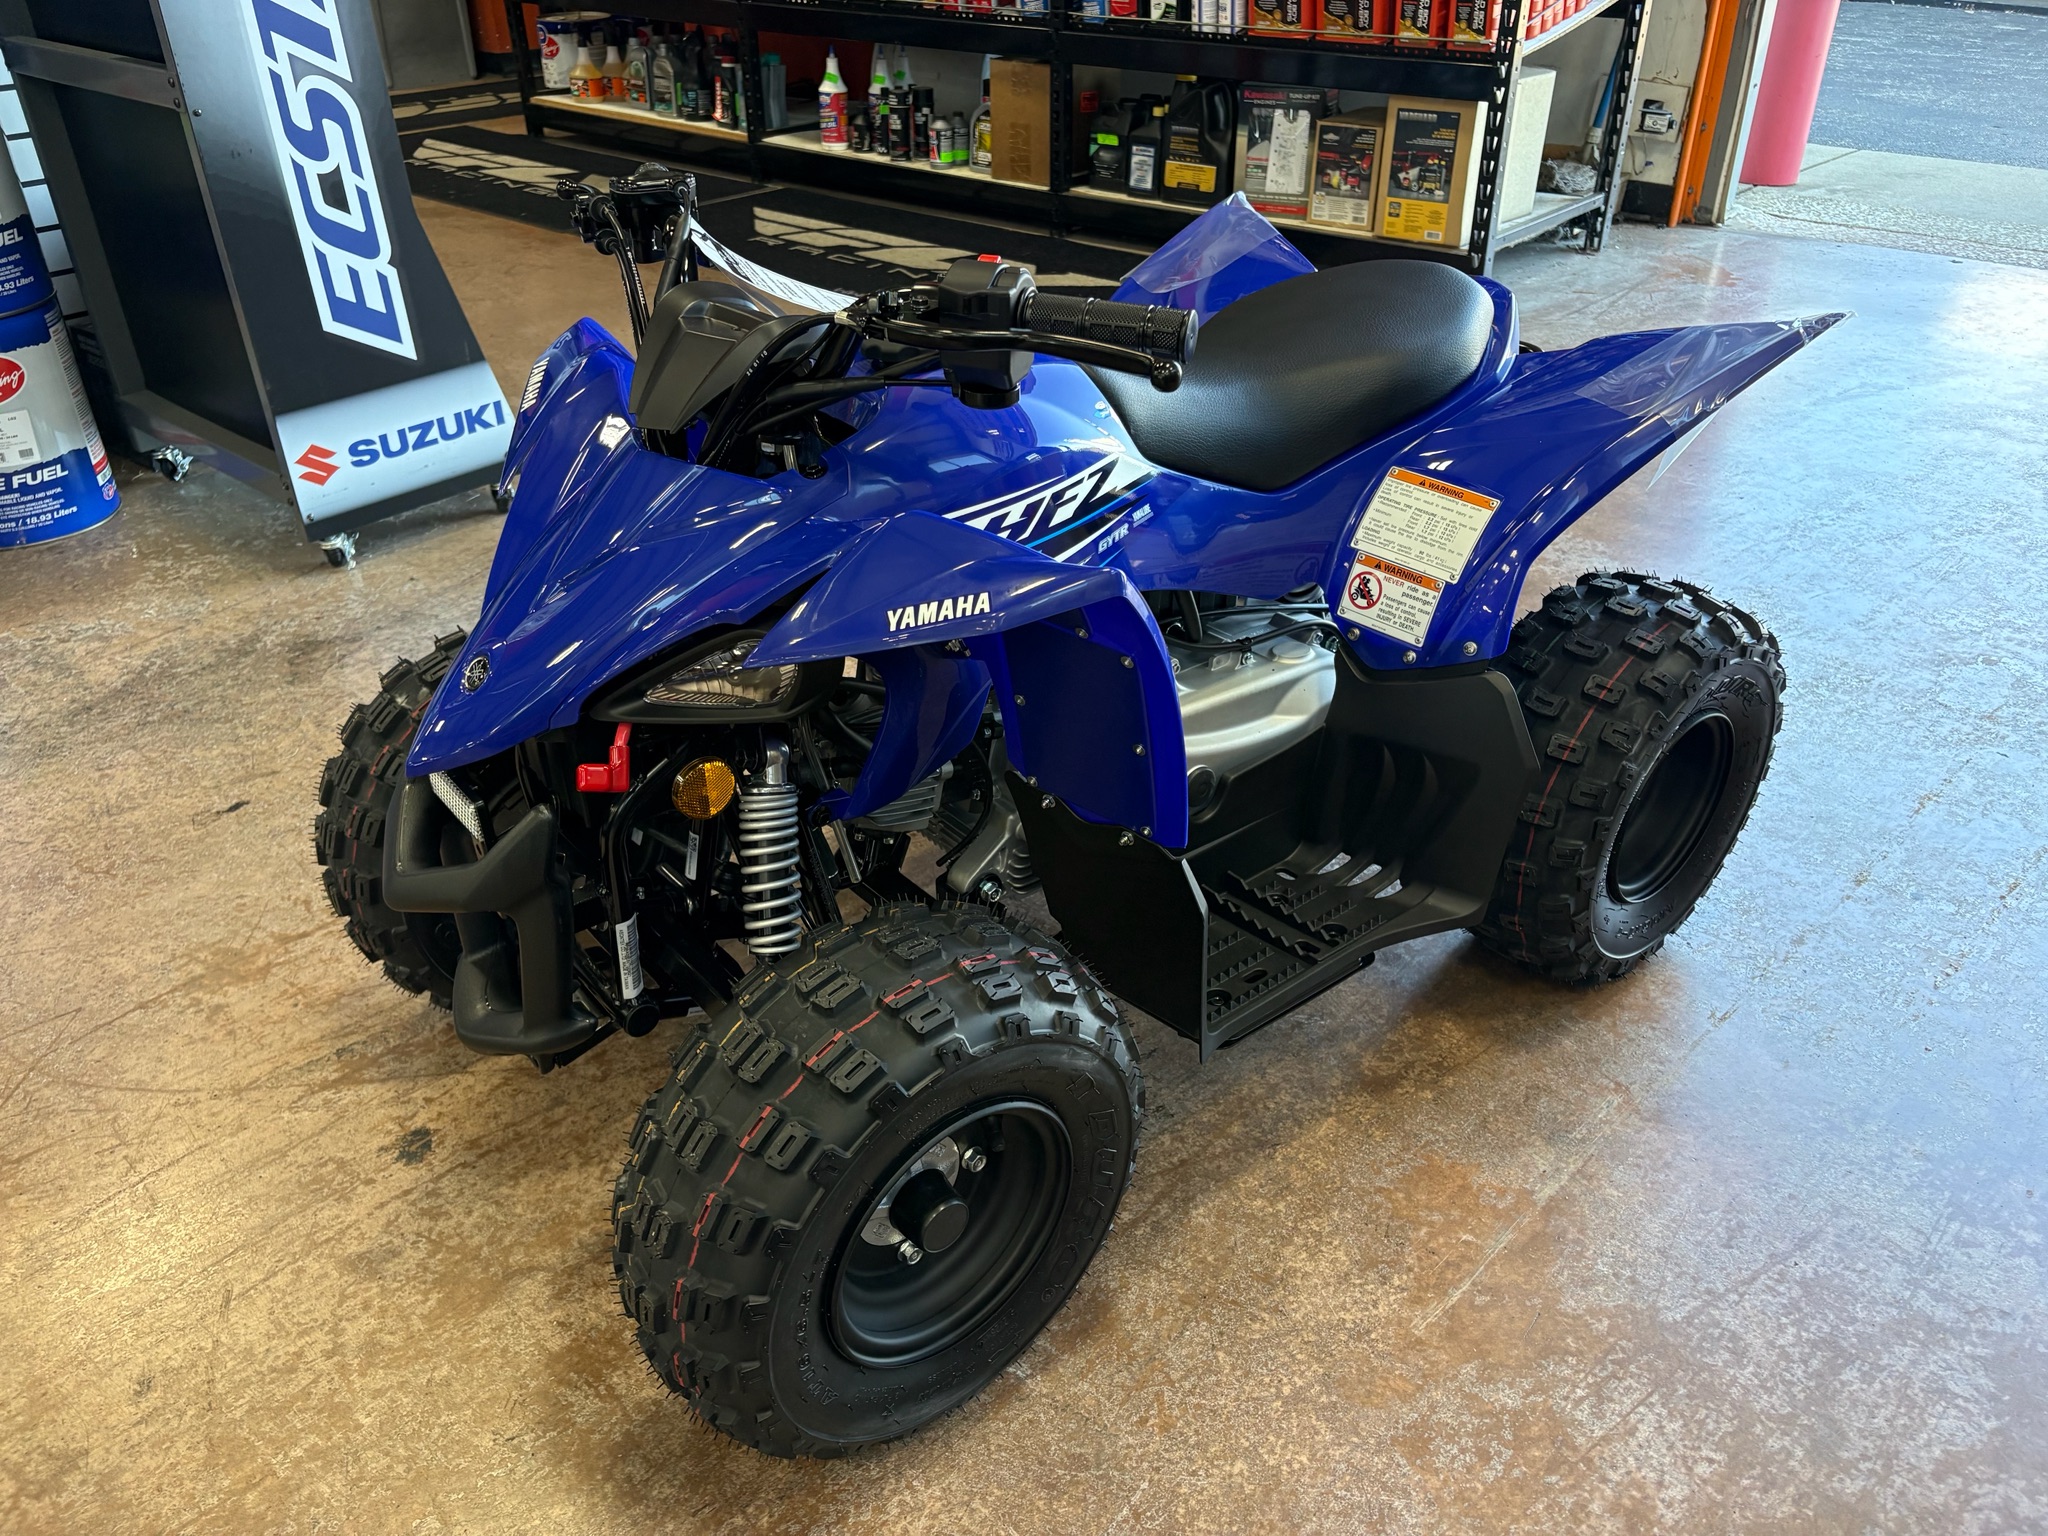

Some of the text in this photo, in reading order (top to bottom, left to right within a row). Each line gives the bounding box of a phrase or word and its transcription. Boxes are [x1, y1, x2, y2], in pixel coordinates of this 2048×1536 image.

[250, 0, 410, 354] ECST
[0, 228, 23, 247] EL
[747, 235, 928, 279] RACIN
[16, 276, 34, 287] Liters
[520, 357, 550, 413] YAMAHA
[348, 400, 505, 467] SUZUKI
[12, 464, 68, 489] FUEL
[1427, 481, 1465, 498] WARNING
[1377, 495, 1401, 505] OPERATING
[25, 513, 52, 524] 18.93
[53, 506, 77, 517] Liters
[1098, 523, 1129, 554] GYTR
[1382, 575, 1404, 587] NEVER
[1406, 584, 1419, 593] ride
[1383, 564, 1423, 584] WARNING
[1382, 593, 1407, 607] Passengers
[1417, 607, 1430, 615] cause
[1401, 591, 1434, 608] passenger.
[887, 592, 991, 631] YAMAHA
[1375, 613, 1391, 623] INJURY
[1377, 606, 1396, 618] resulting
[1403, 616, 1421, 626] SEVERE
